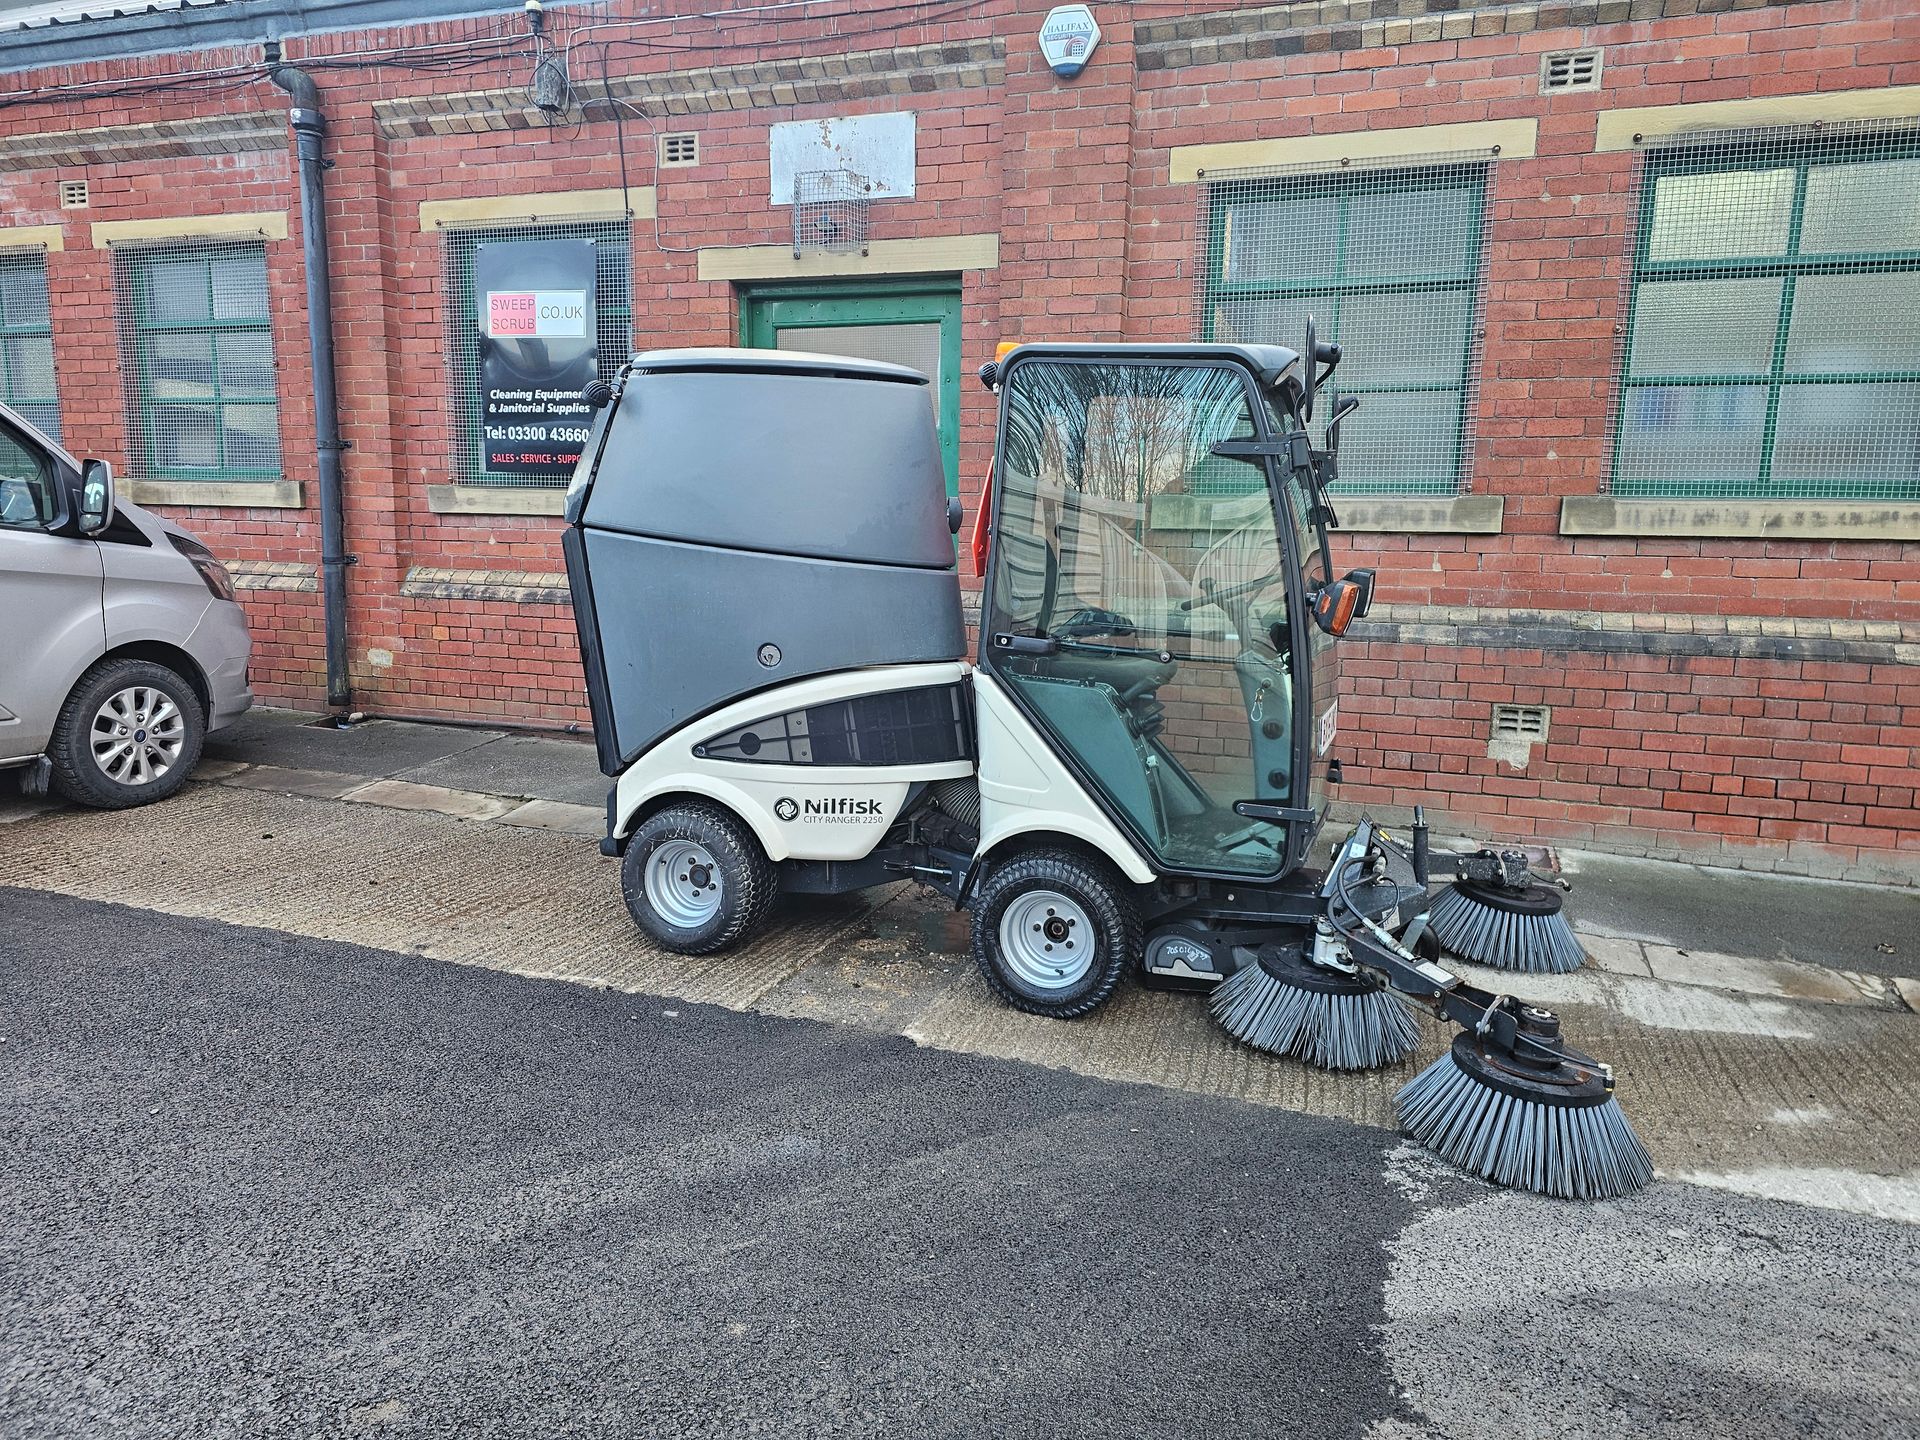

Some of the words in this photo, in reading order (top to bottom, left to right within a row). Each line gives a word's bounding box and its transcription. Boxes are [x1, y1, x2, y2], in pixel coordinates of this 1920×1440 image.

[1048, 22, 1088, 33] HALIFAX
[491, 298, 535, 311] SWEEP
[537, 305, 583, 319] .CO.UK
[492, 318, 535, 330] SCRUB
[490, 389, 533, 401] Cleaning
[489, 403, 497, 413] &
[498, 402, 546, 413] Janitorial
[547, 402, 591, 415] Supplies
[484, 425, 506, 440] Tel:
[507, 426, 546, 441] 03300
[549, 427, 590, 442] 43660
[492, 453, 515, 463] SALES
[520, 453, 551, 463] SERVICE
[557, 454, 582, 464] SUPPO
[804, 798, 883, 814] Nilfisk
[803, 815, 824, 824] CITY
[825, 815, 861, 824] RANGER
[862, 815, 884, 824] 2250
